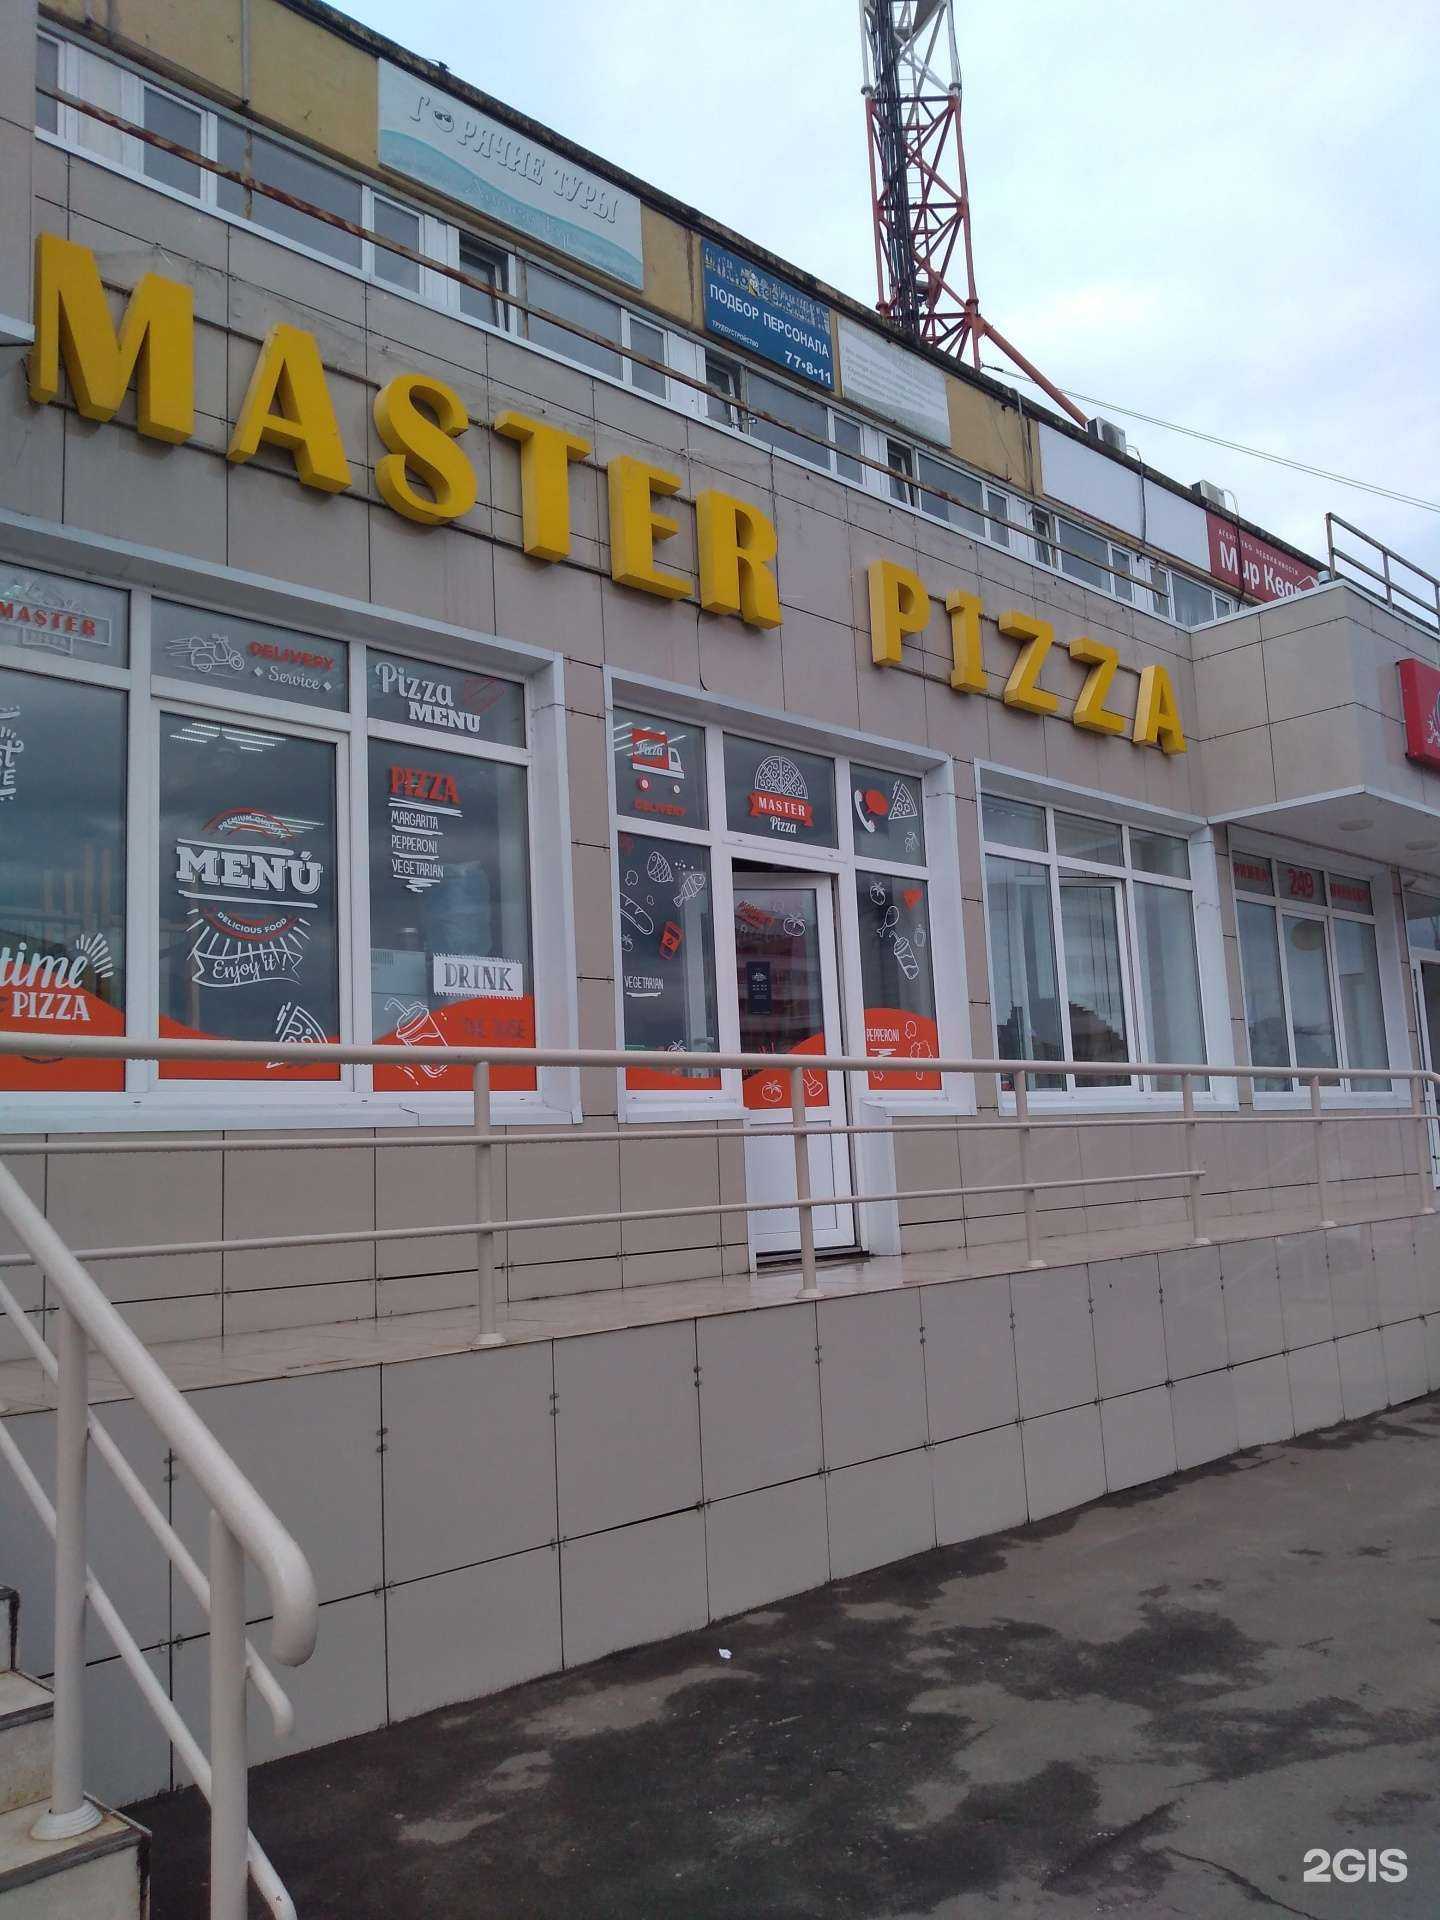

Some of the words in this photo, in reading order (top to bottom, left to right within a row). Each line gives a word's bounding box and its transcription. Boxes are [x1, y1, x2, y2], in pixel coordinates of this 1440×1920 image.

[552, 169, 620, 224] ТУРЫ
[710, 284, 759, 319] ПОДБОР
[763, 312, 830, 359] ПЕРСОНАЛА
[29, 231, 784, 631] MASTER
[867, 559, 1189, 756] PIZZA
[1219, 540, 1260, 591] Мир
[0, 598, 96, 639] MASTER
[268, 665, 321, 690] Service
[375, 662, 454, 707] Pizza
[408, 701, 481, 733] MENU
[391, 810, 439, 830] MARGARITA
[758, 796, 805, 817] MASTER
[769, 815, 797, 834] Pizza
[391, 834, 438, 854] PEPPERONI
[391, 858, 444, 878] VEGETARIAN
[212, 959, 260, 985] Enjoy
[444, 962, 514, 992] DRINK
[623, 975, 664, 991] VEGETARIAN
[11, 991, 91, 1021] PIZZA
[866, 1028, 900, 1042] PEPPERONI
